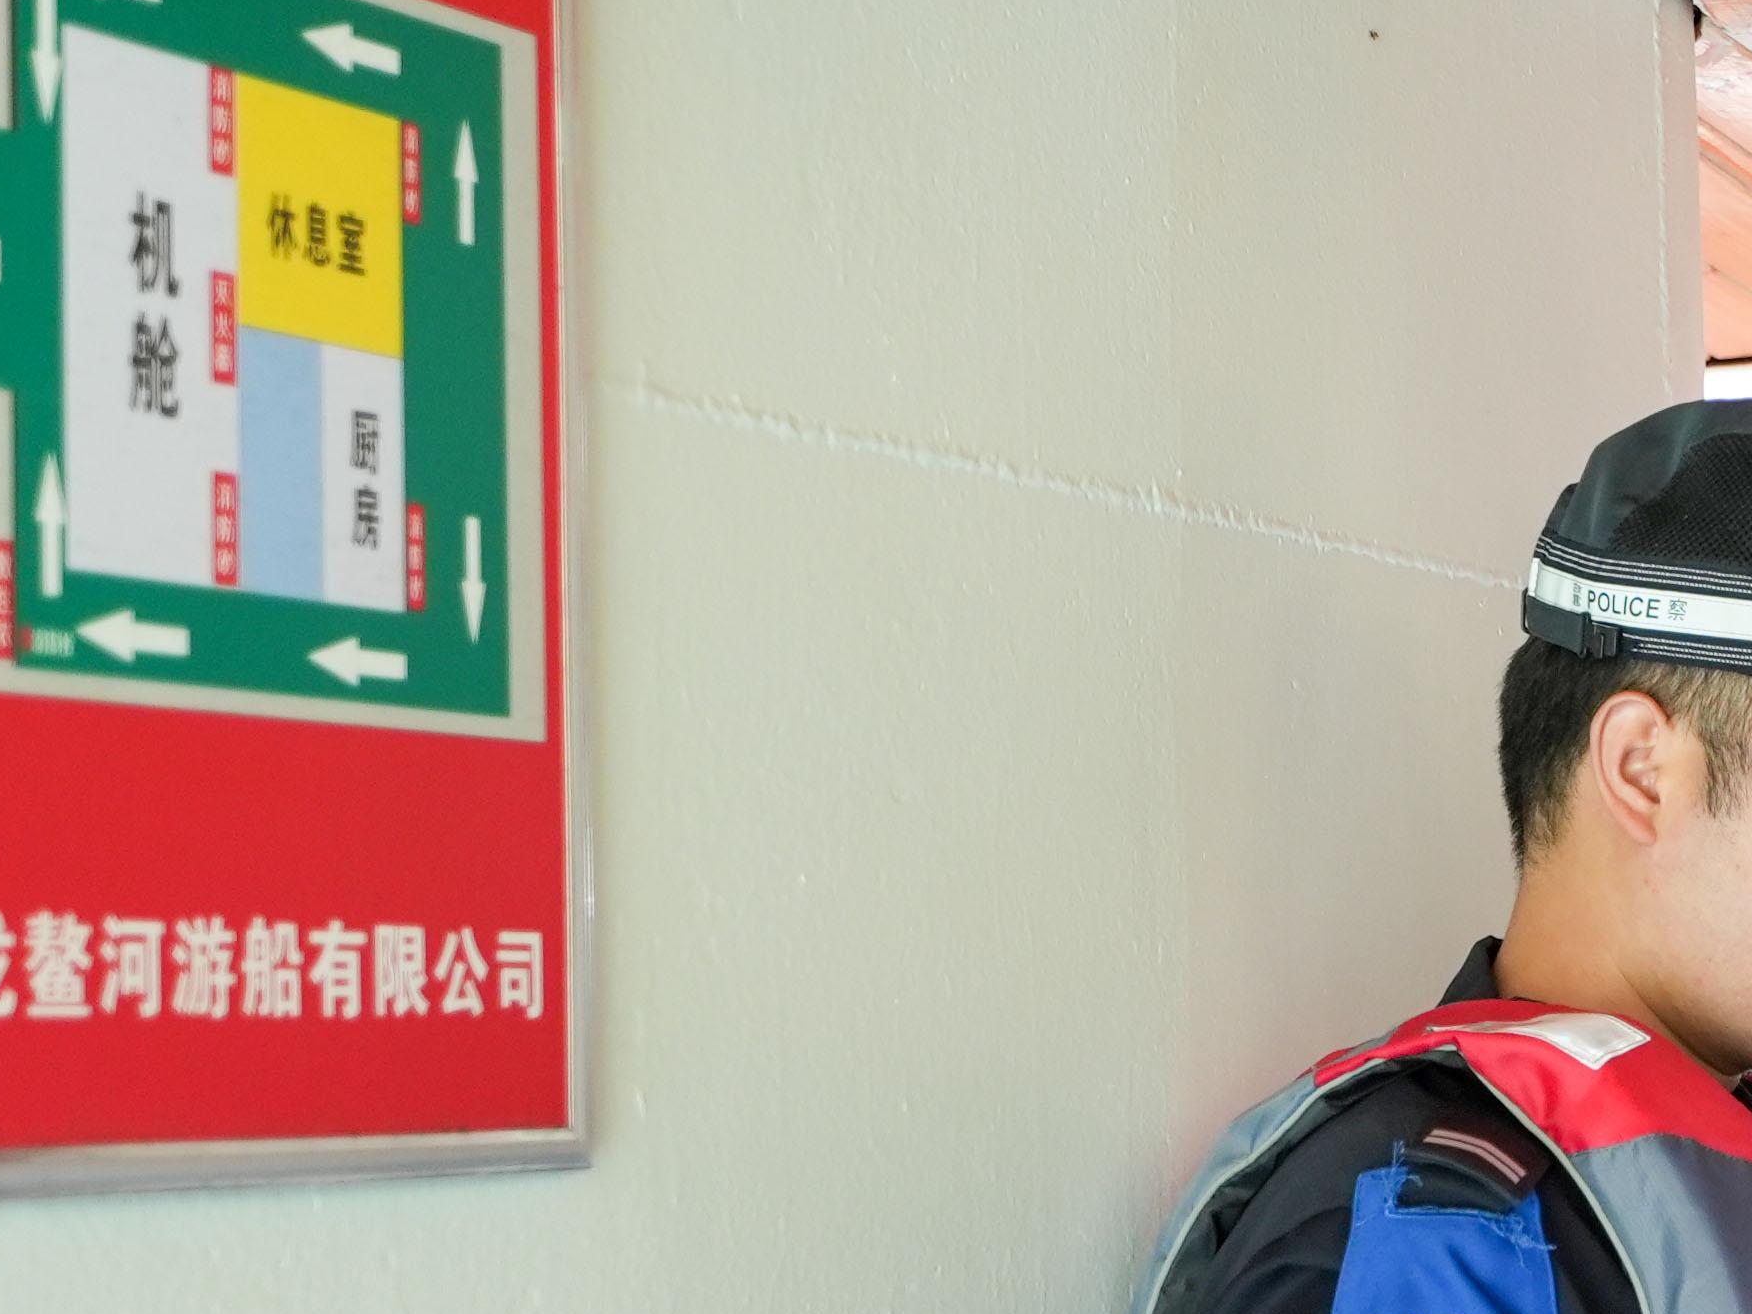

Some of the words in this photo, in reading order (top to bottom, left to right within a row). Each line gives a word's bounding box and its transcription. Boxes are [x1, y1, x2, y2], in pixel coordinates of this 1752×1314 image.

[266, 190, 366, 277] 休息室
[128, 190, 182, 419] 机舱
[351, 410, 381, 551] 厨房
[1587, 589, 1661, 620] POLICE
[1667, 598, 1689, 622] 察
